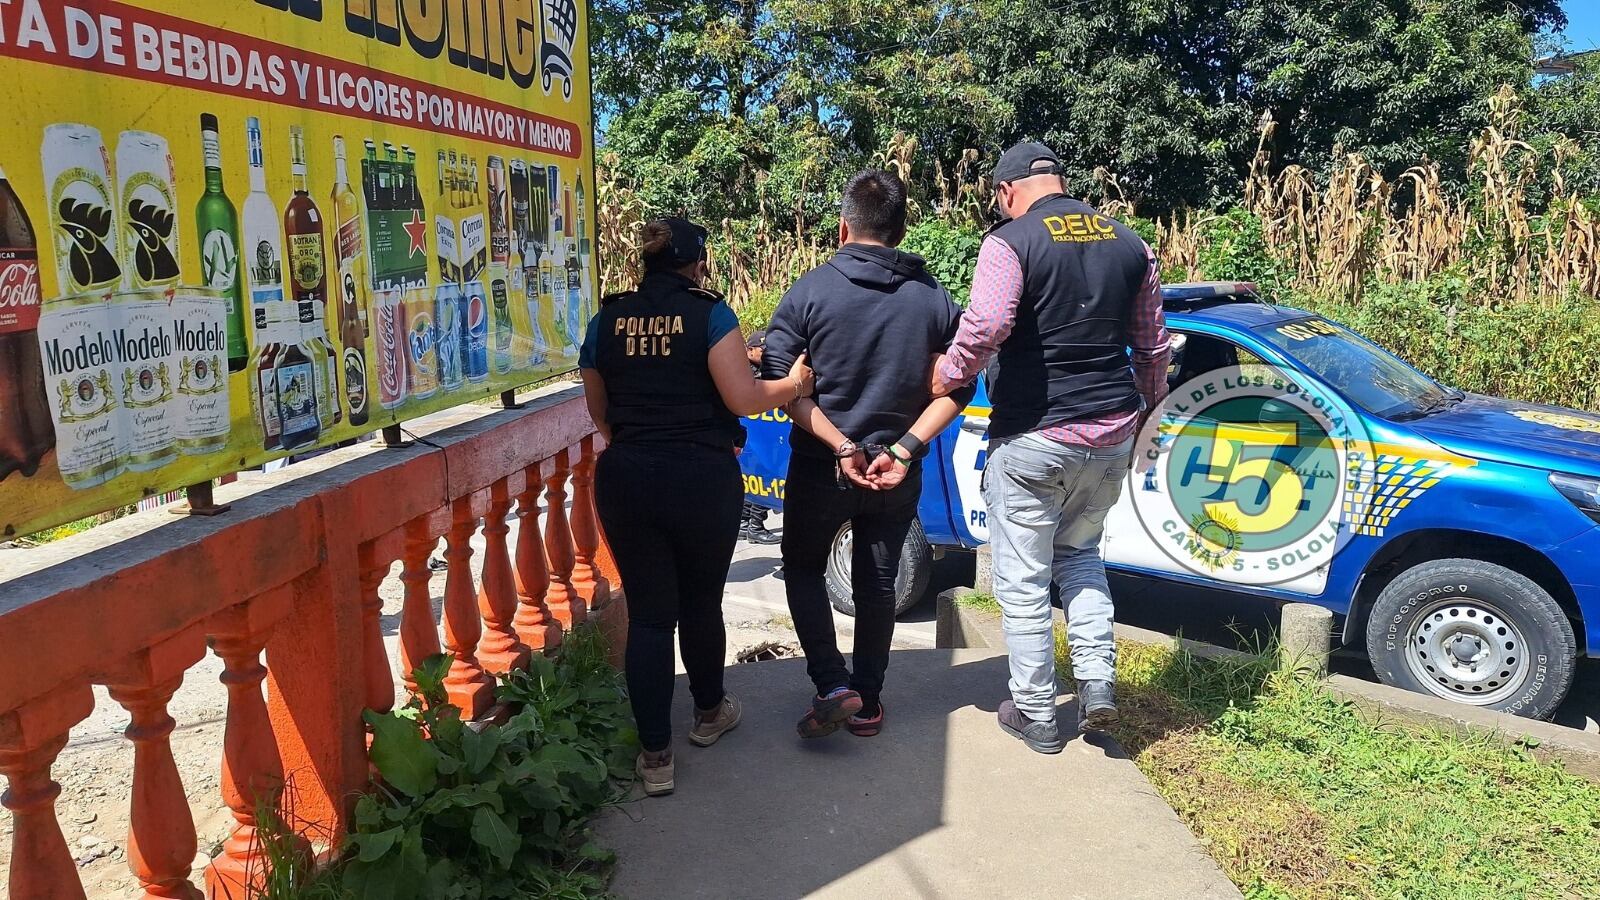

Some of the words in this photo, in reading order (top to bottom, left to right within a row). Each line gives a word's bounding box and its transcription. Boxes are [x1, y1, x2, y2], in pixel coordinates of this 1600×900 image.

[63, 5, 126, 66] DE
[132, 22, 287, 96] BEBIDAS
[290, 60, 310, 100] Y
[317, 66, 412, 121] LICORES
[416, 91, 454, 129] POR
[457, 95, 515, 141] MAYOR
[517, 117, 527, 143] Y
[529, 119, 572, 153] MENOR
[462, 219, 482, 238] Corona
[1043, 214, 1114, 235] DEIC
[1074, 233, 1103, 242] NACIONAL
[1102, 232, 1118, 240] CIVIL
[299, 249, 314, 257] ORO
[174, 319, 225, 351] Modelo
[614, 316, 684, 336] POLICIA
[45, 331, 113, 376] Modelo
[113, 326, 171, 363] Modelo
[626, 335, 671, 356] DEIC
[1500, 654, 1547, 714] DESTINAT
